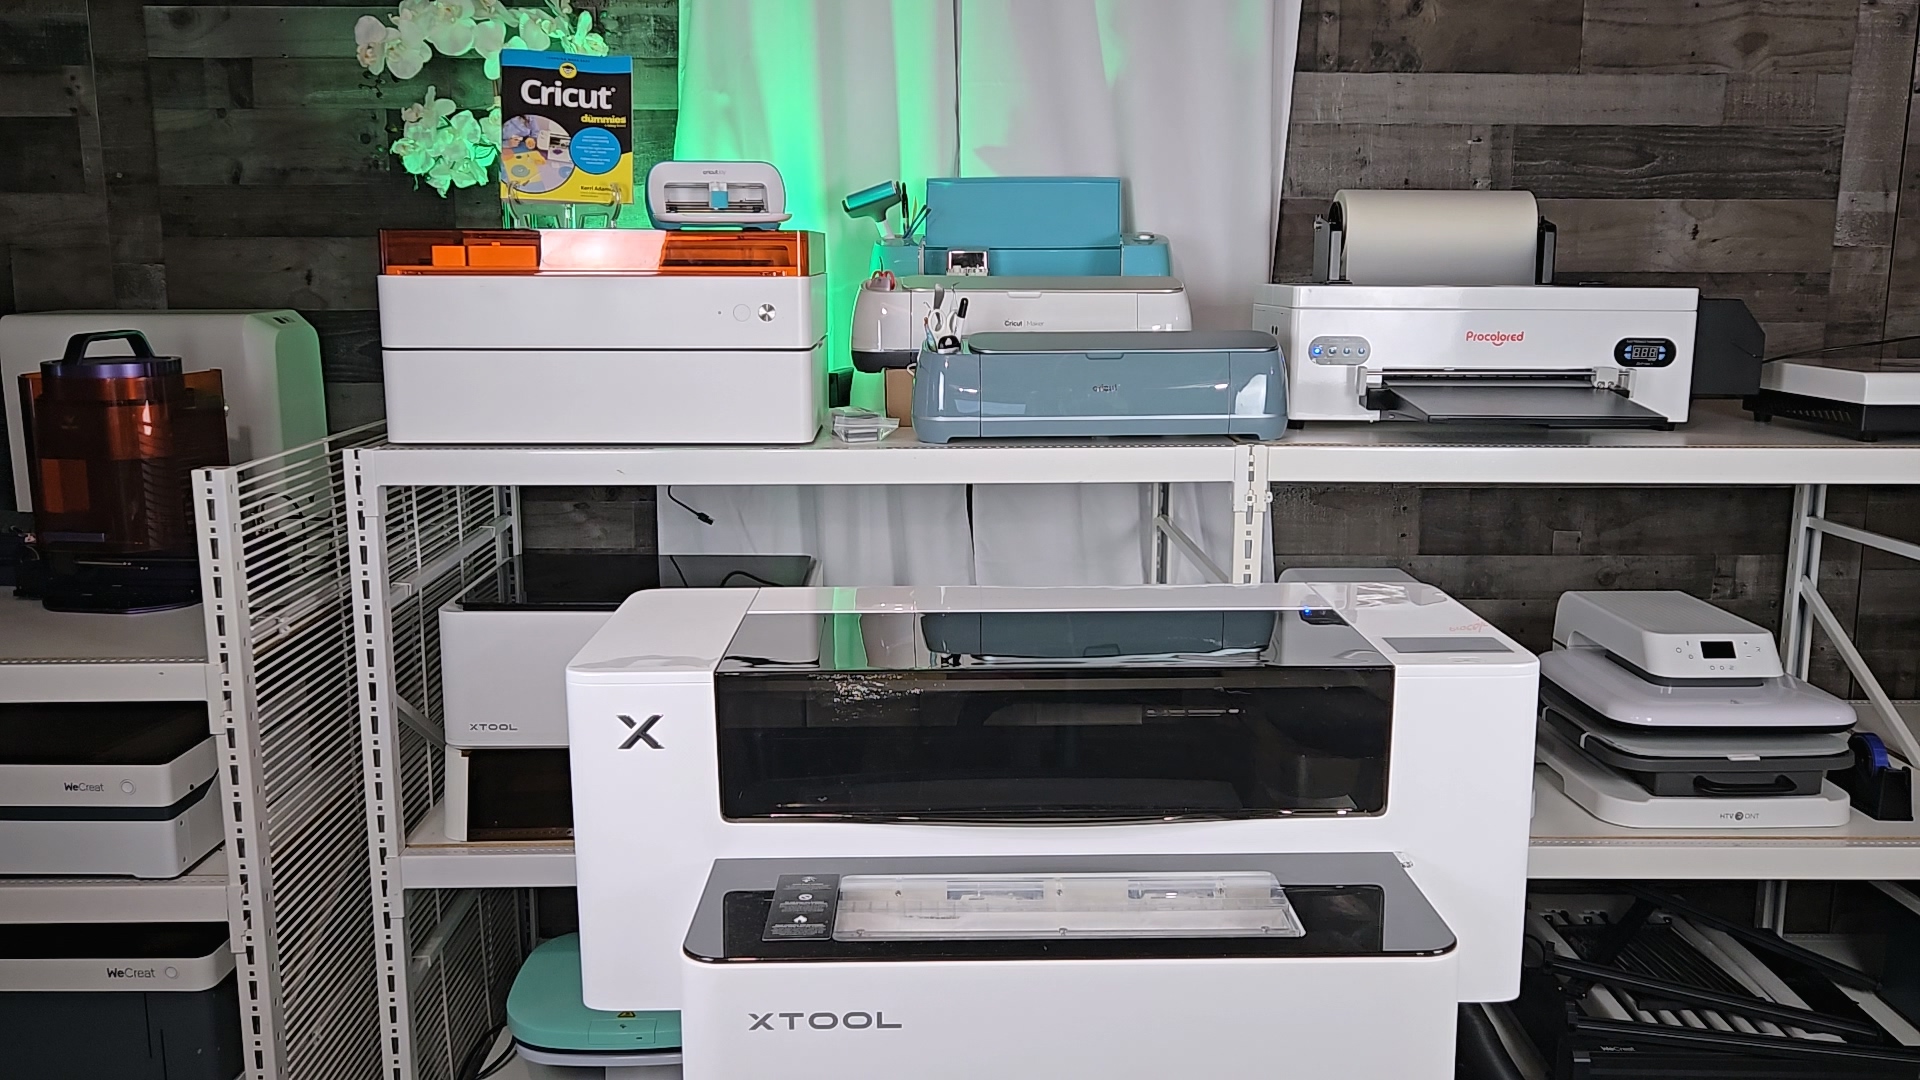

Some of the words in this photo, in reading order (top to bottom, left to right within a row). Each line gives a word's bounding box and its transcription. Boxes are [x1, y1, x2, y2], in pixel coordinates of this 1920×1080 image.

[580, 113, 627, 124] dummies
[1465, 330, 1525, 343] Procolored
[469, 723, 518, 731] XTOOL
[64, 782, 104, 792] WeCreat
[106, 967, 156, 978] WeCreat
[747, 1011, 903, 1031] XTOOL
